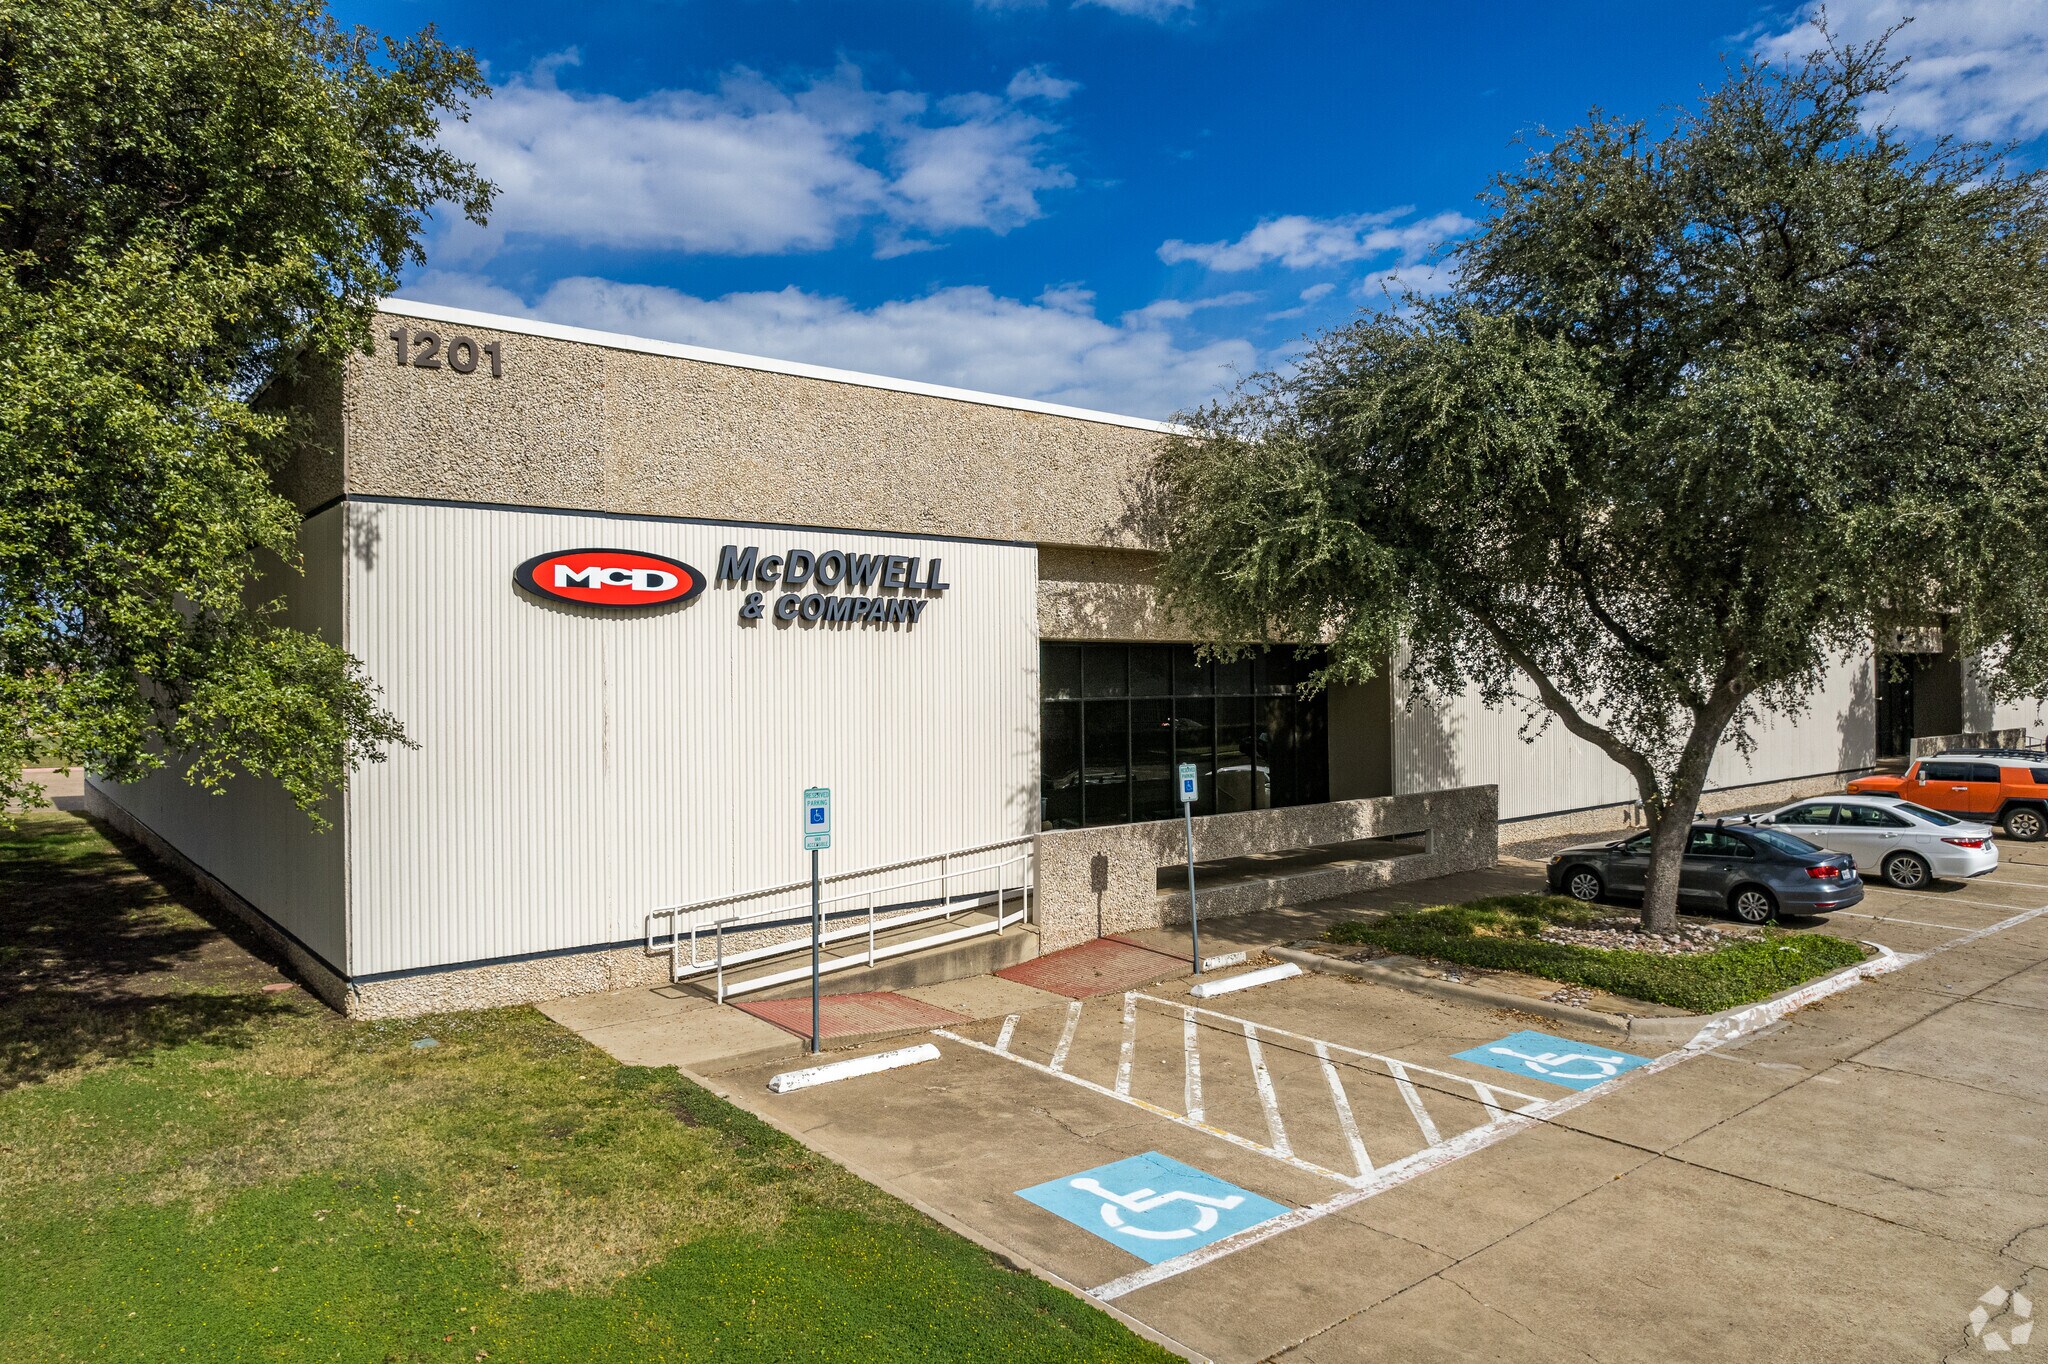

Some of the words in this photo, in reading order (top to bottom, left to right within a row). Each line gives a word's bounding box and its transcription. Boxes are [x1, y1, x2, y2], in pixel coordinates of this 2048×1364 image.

[390, 327, 501, 377] 1201
[740, 592, 765, 619] &
[774, 593, 928, 624] COMPANY
